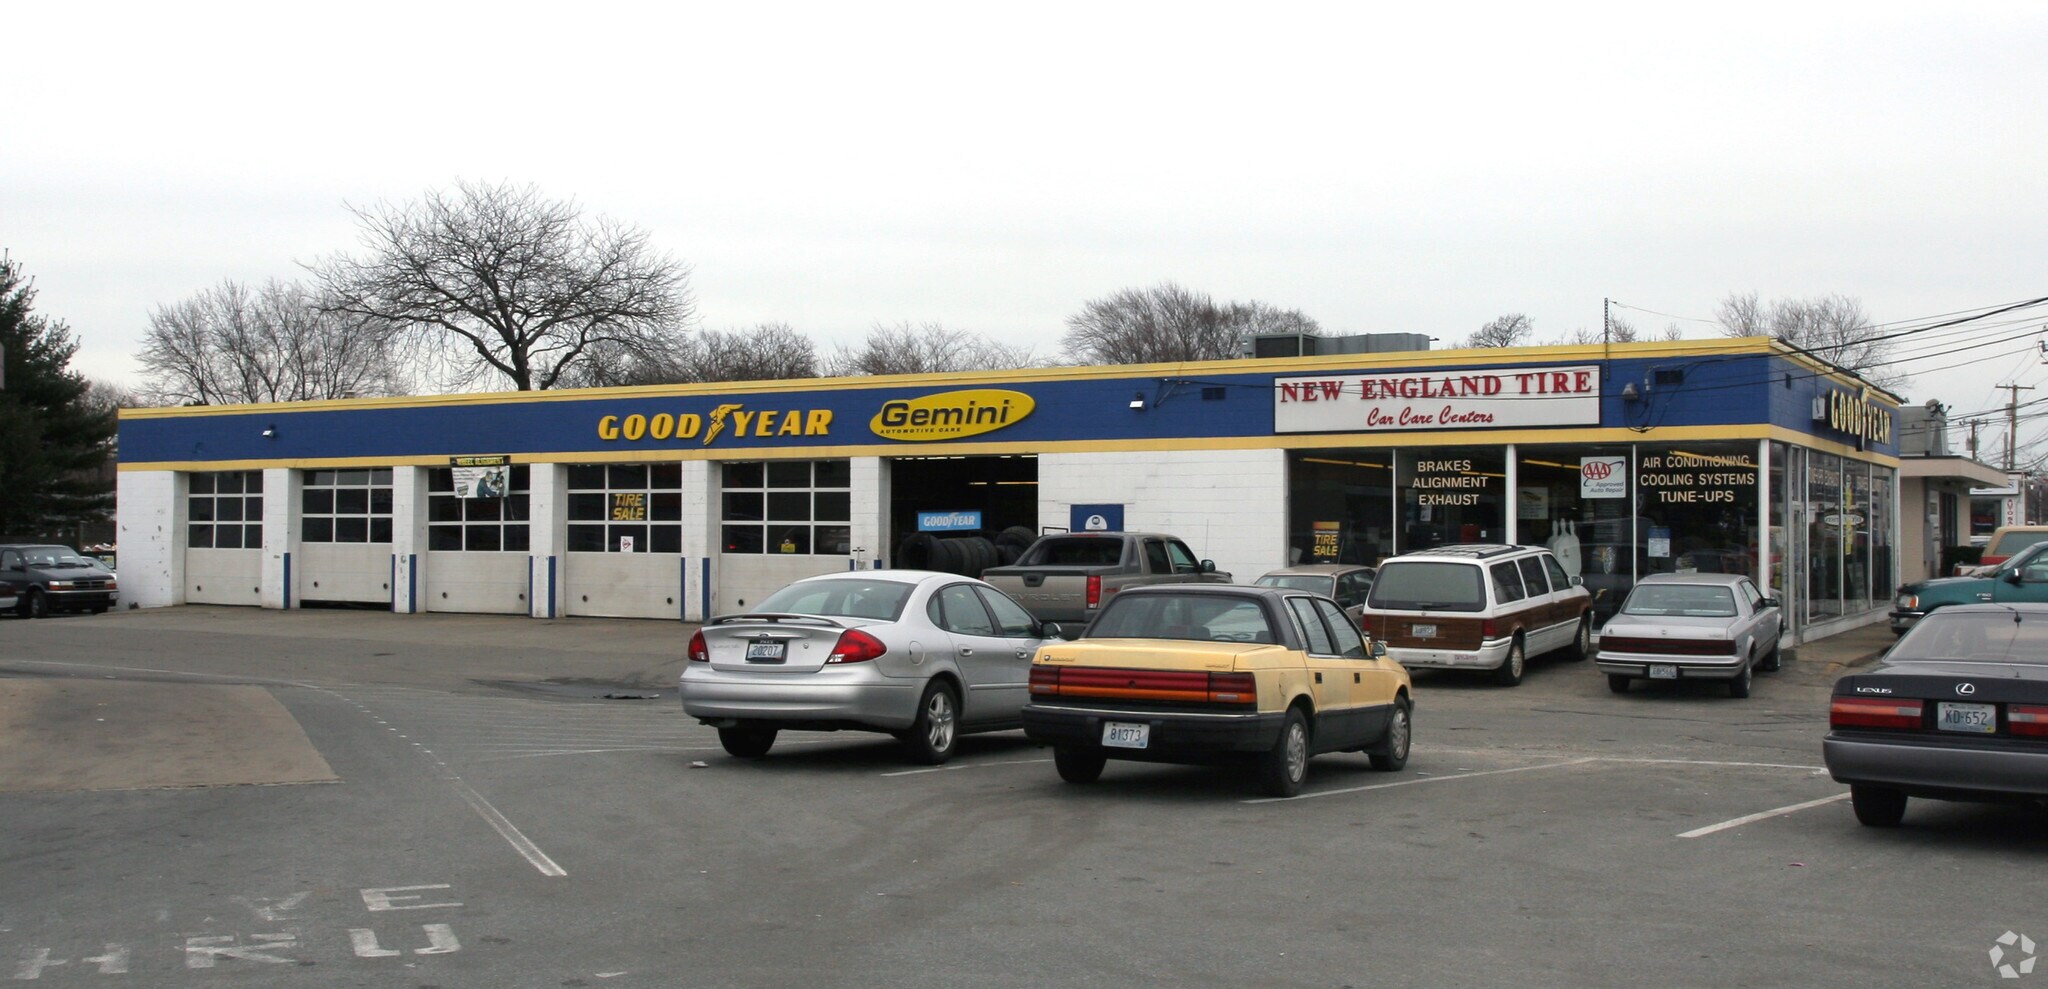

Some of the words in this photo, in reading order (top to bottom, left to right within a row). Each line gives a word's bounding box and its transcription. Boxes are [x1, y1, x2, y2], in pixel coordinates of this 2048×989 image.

[1280, 380, 1344, 403] NEW
[1360, 376, 1502, 400] ENGLAND
[1515, 371, 1593, 395] TIRE
[881, 399, 1010, 427] Gemini
[1367, 406, 1394, 427] Car
[1399, 405, 1433, 426] Care
[1439, 404, 1494, 426] Centers
[1417, 459, 1471, 472] BRAKES
[1643, 457, 1661, 468] AIR
[1666, 455, 1749, 468] CONDITIONING
[1584, 462, 1609, 479] AAA
[1412, 476, 1488, 488] ALIGNMENT
[1640, 474, 1693, 486] COOLING
[1699, 473, 1755, 485] SYSTEMS
[615, 493, 643, 506] TIRE
[1418, 494, 1479, 506] EXHAUST
[1658, 490, 1734, 503] TUNE-UPS
[612, 507, 644, 520] SALE
[1314, 534, 1338, 545] TIRE
[1313, 545, 1338, 556] SALE
[1857, 686, 1892, 694] LEXUS
[1110, 728, 1141, 742] 81373
